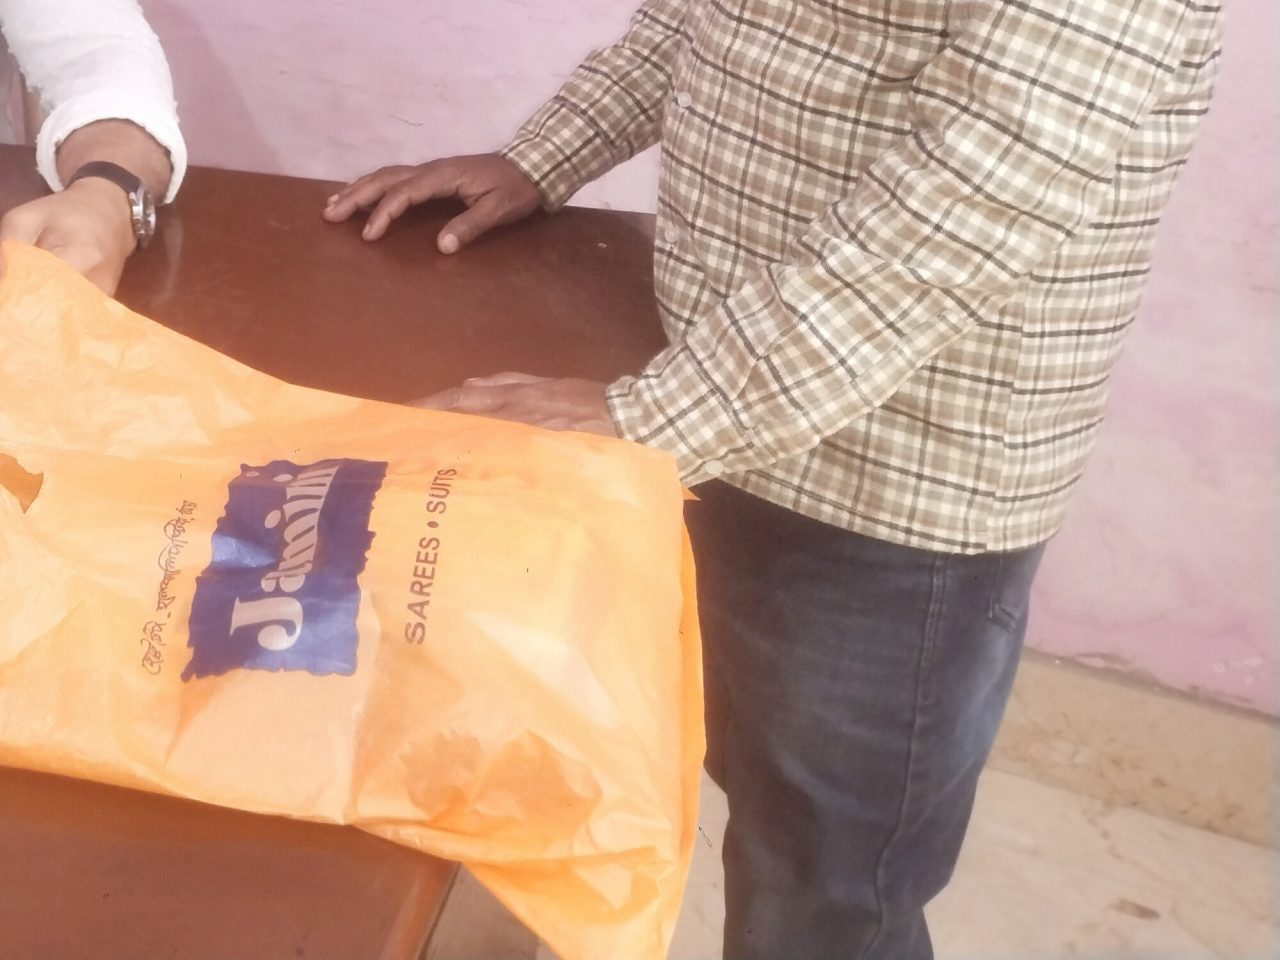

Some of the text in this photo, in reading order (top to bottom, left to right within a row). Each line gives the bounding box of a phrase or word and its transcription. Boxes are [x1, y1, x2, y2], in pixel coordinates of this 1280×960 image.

[230, 465, 339, 651] Jamini
[405, 468, 458, 645] SAREES SUITS
